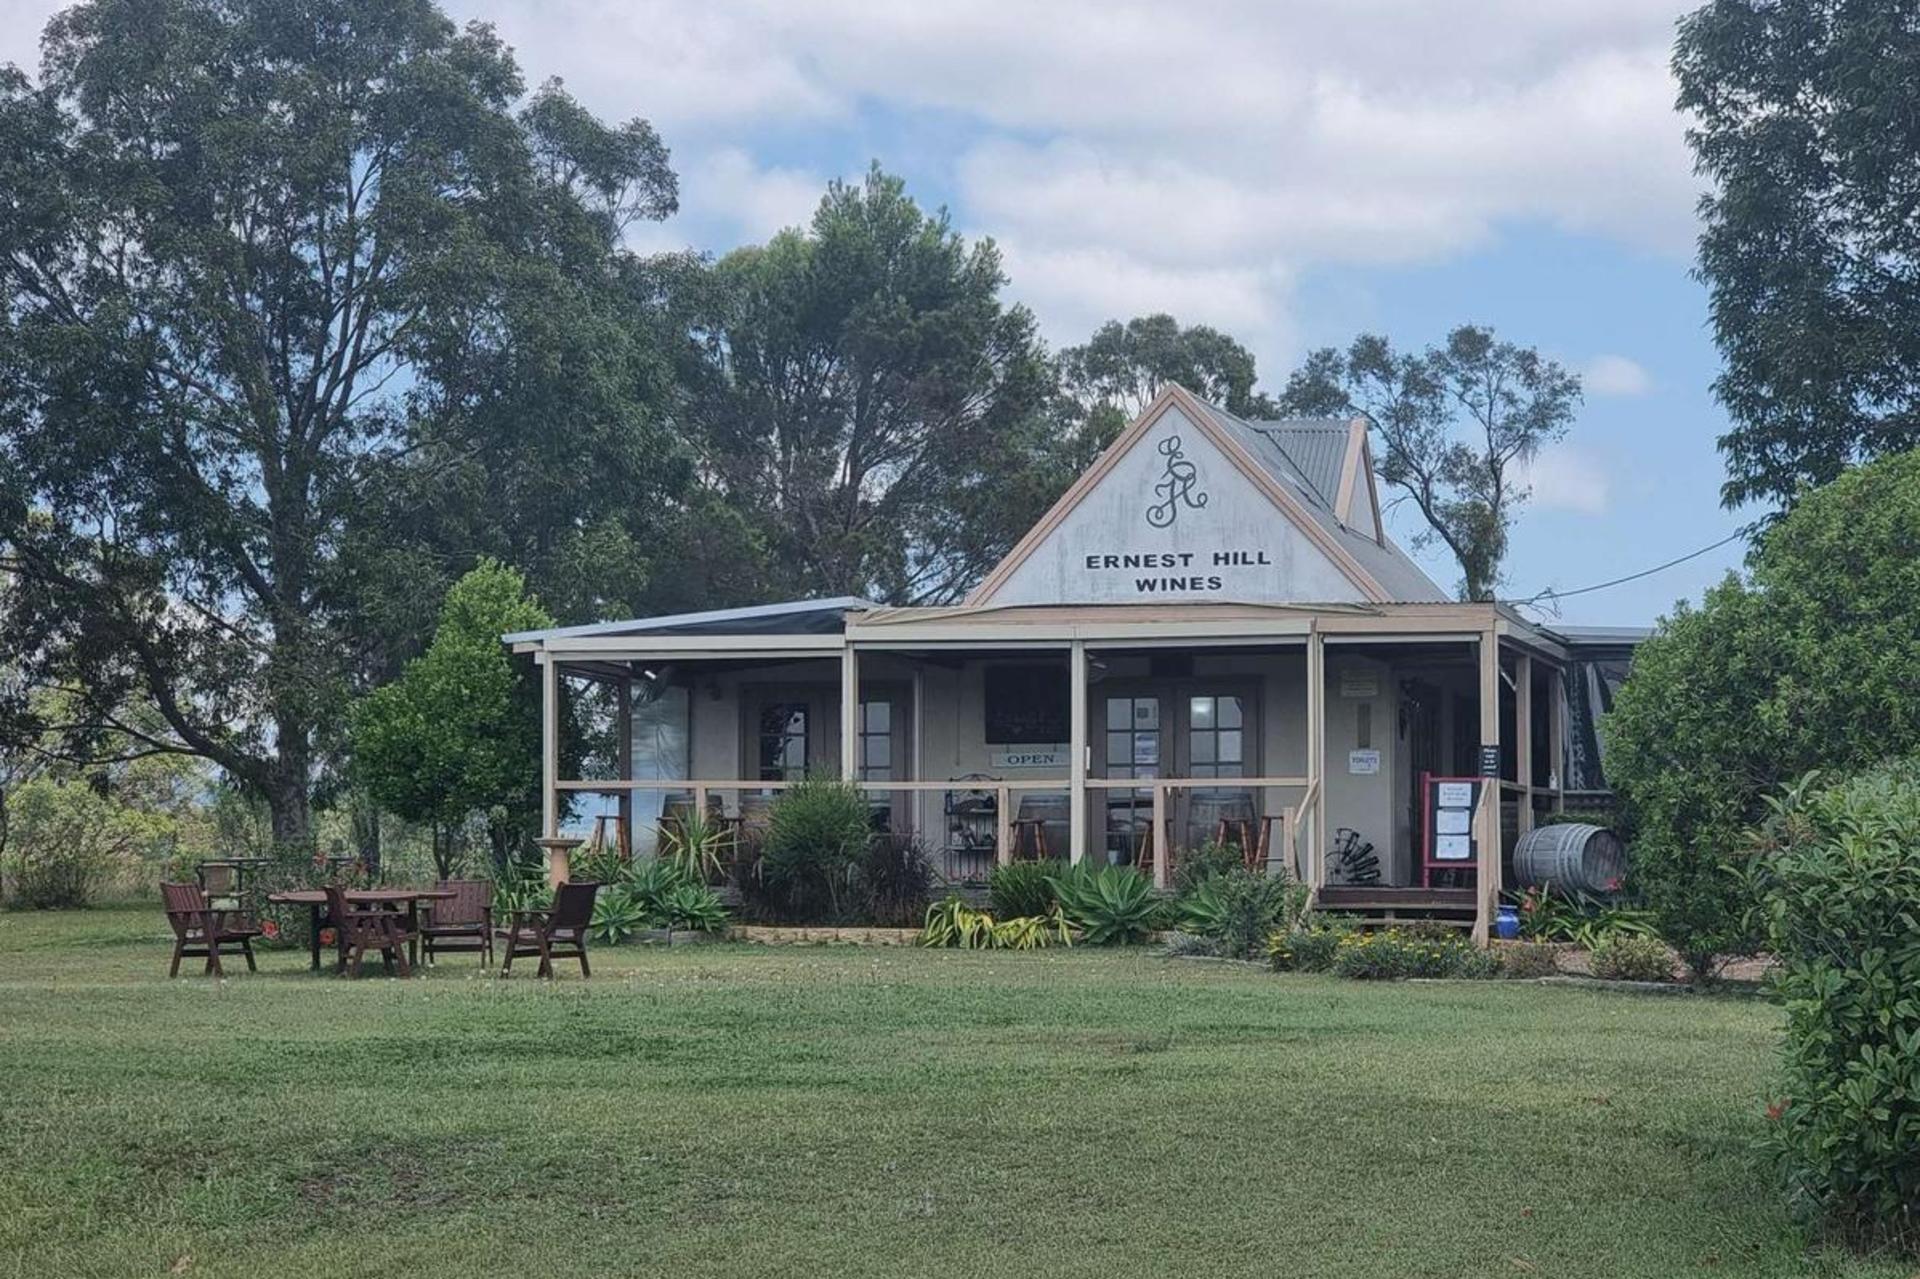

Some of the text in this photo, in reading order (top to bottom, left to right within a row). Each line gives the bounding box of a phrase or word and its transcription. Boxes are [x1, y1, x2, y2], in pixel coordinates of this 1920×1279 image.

[1086, 552, 1272, 569] ERNEST HILL
[1135, 576, 1223, 592] WINES
[1007, 754, 1055, 765] OPEN
